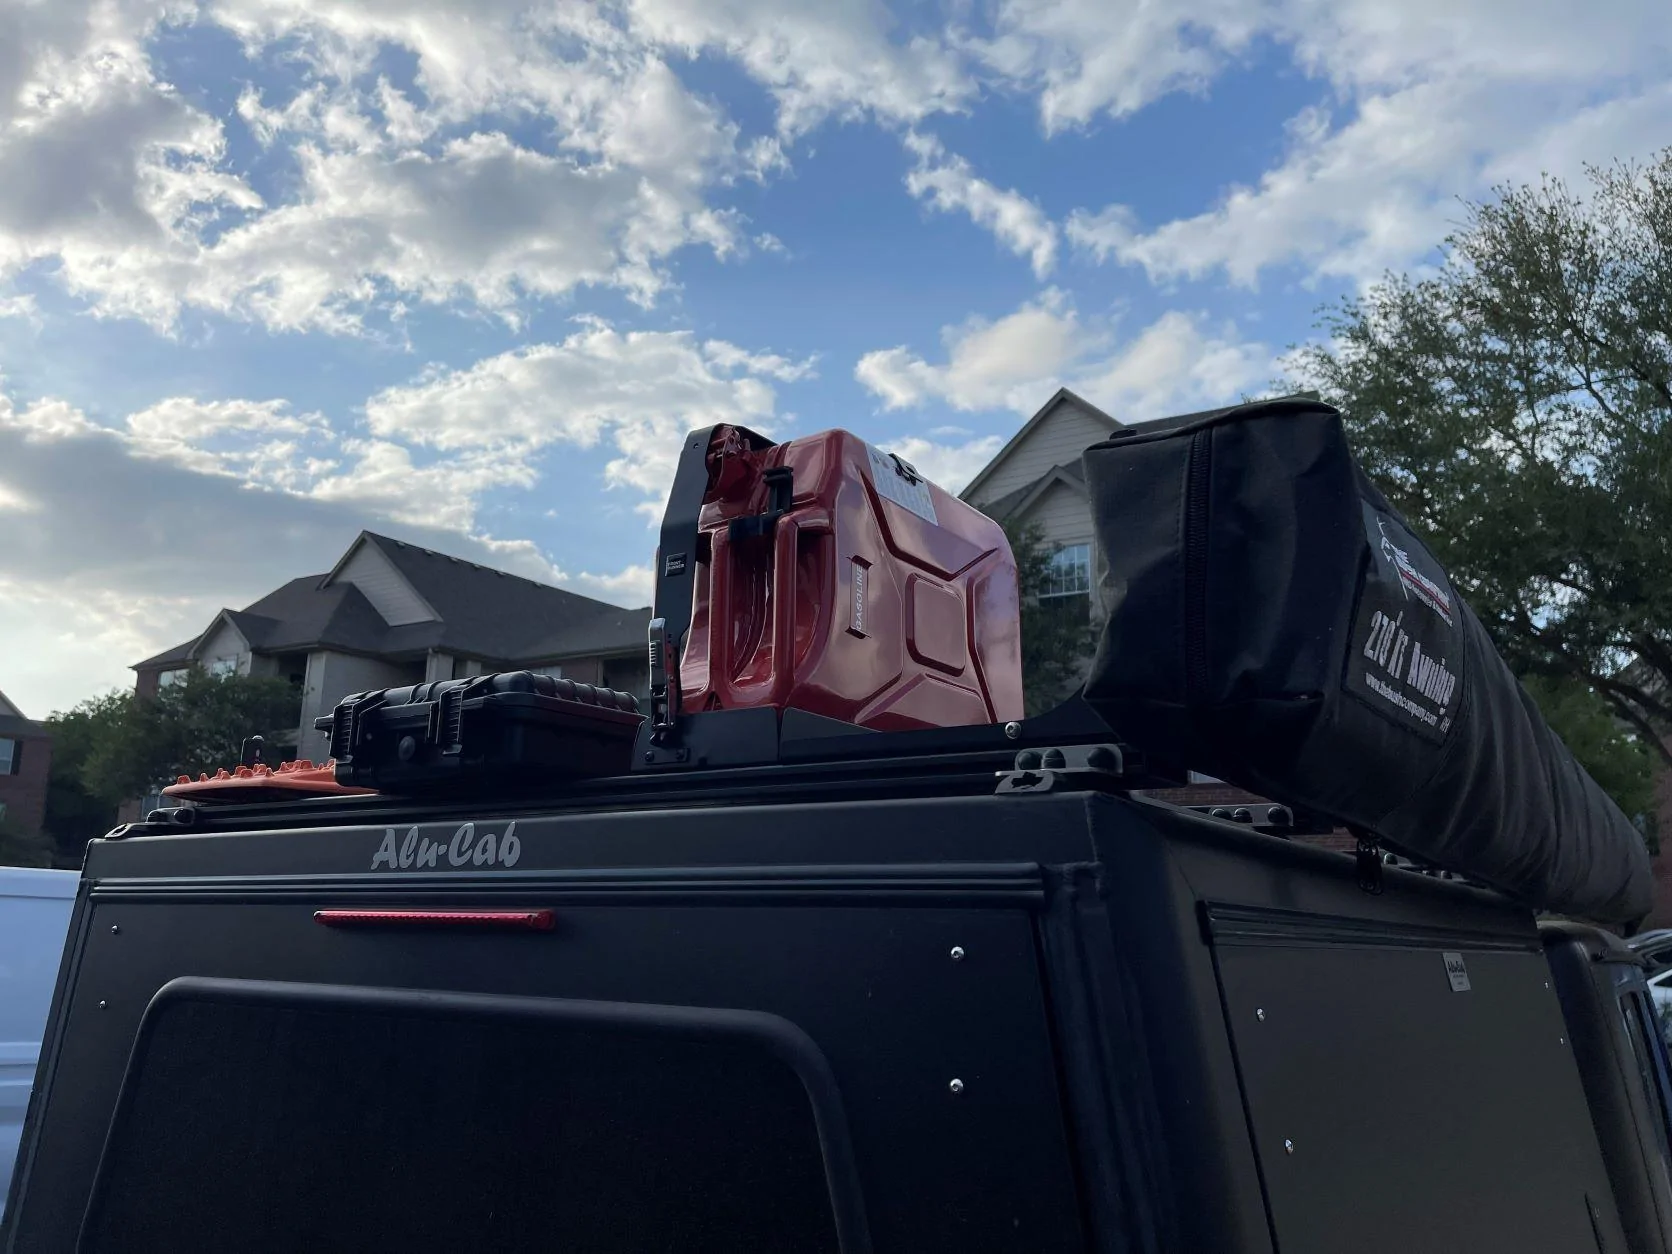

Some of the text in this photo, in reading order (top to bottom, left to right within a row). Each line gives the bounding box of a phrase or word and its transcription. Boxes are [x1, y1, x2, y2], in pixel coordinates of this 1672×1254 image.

[855, 564, 863, 630] GASOLINE
[1406, 641, 1456, 715] Awning
[370, 820, 521, 870] Alu-Cab
